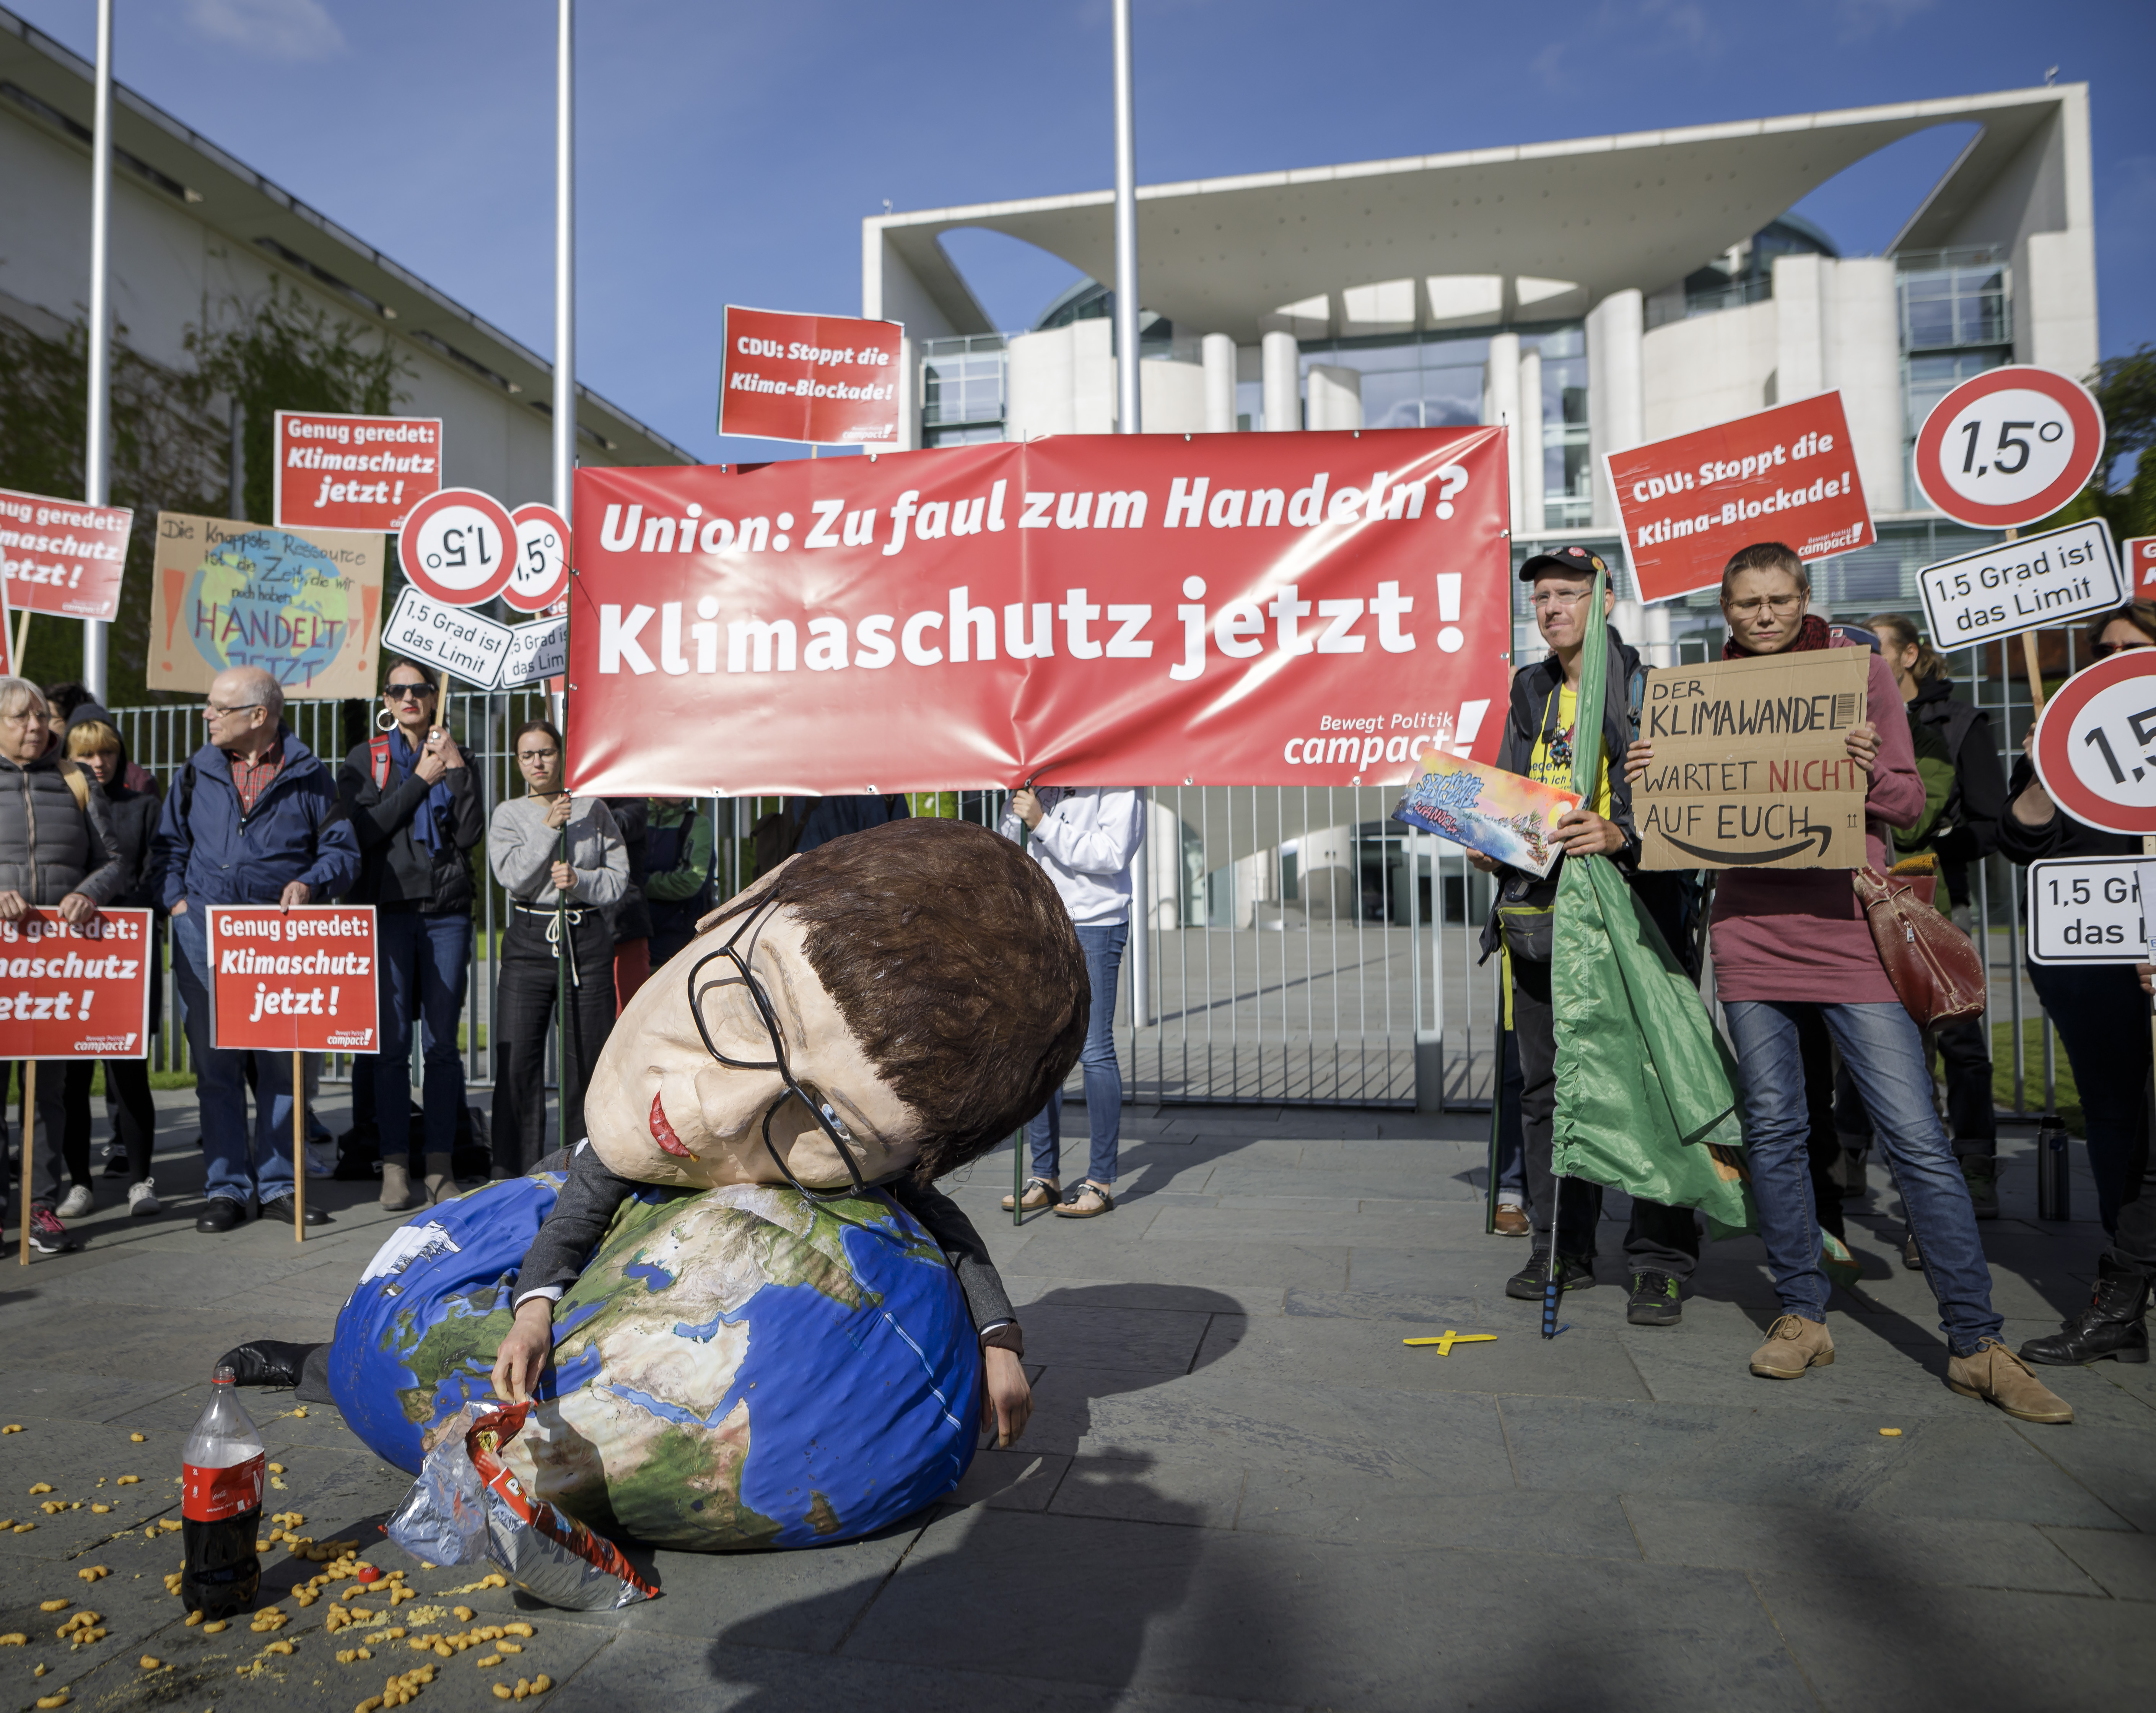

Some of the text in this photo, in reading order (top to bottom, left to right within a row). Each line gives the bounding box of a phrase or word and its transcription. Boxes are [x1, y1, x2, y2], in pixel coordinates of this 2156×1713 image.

[737, 336, 889, 366] CDU: Stoppt die
[730, 372, 894, 401] Klima-Blockade!
[288, 418, 434, 445] Genug geredet:
[287, 445, 435, 474] Klimaschutz
[1961, 420, 2063, 479] 1,5°
[1632, 431, 1833, 503] CDU: Stoppt die
[36, 507, 122, 531] geredet:
[600, 464, 1469, 556] Union: Zu faul zum Handeln?
[1637, 471, 1851, 548] Klima-Blockade!
[0, 528, 120, 561] maschutz
[161, 519, 194, 539] Die
[282, 535, 366, 566] Ressource
[204, 550, 225, 567] ist
[236, 555, 256, 573] die
[311, 570, 329, 589] die
[335, 577, 355, 592] wir
[1935, 540, 2094, 603] 1,5 Grad ist
[231, 584, 255, 600] noch
[1957, 575, 2091, 631] das Limit
[195, 599, 342, 650] HANDELT
[404, 600, 502, 653] 1,5 Grad ist
[525, 630, 555, 650] Grad
[598, 585, 1153, 675] Klimaschutz
[402, 629, 486, 673] das Limit
[513, 661, 535, 676] das
[1652, 680, 1705, 700] DER
[1320, 711, 1453, 733] Bewegt Politik
[1650, 694, 1846, 738] KLIMAWANDEL
[1644, 758, 1855, 793] WARTET NICHT
[1644, 804, 1809, 840] AUF EUCH
[2048, 878, 2091, 907] 1,5
[26, 916, 139, 944] geredet:
[220, 914, 369, 942] Genug geredet:
[2063, 918, 2124, 945] das
[220, 947, 371, 975] Klimaschutz
